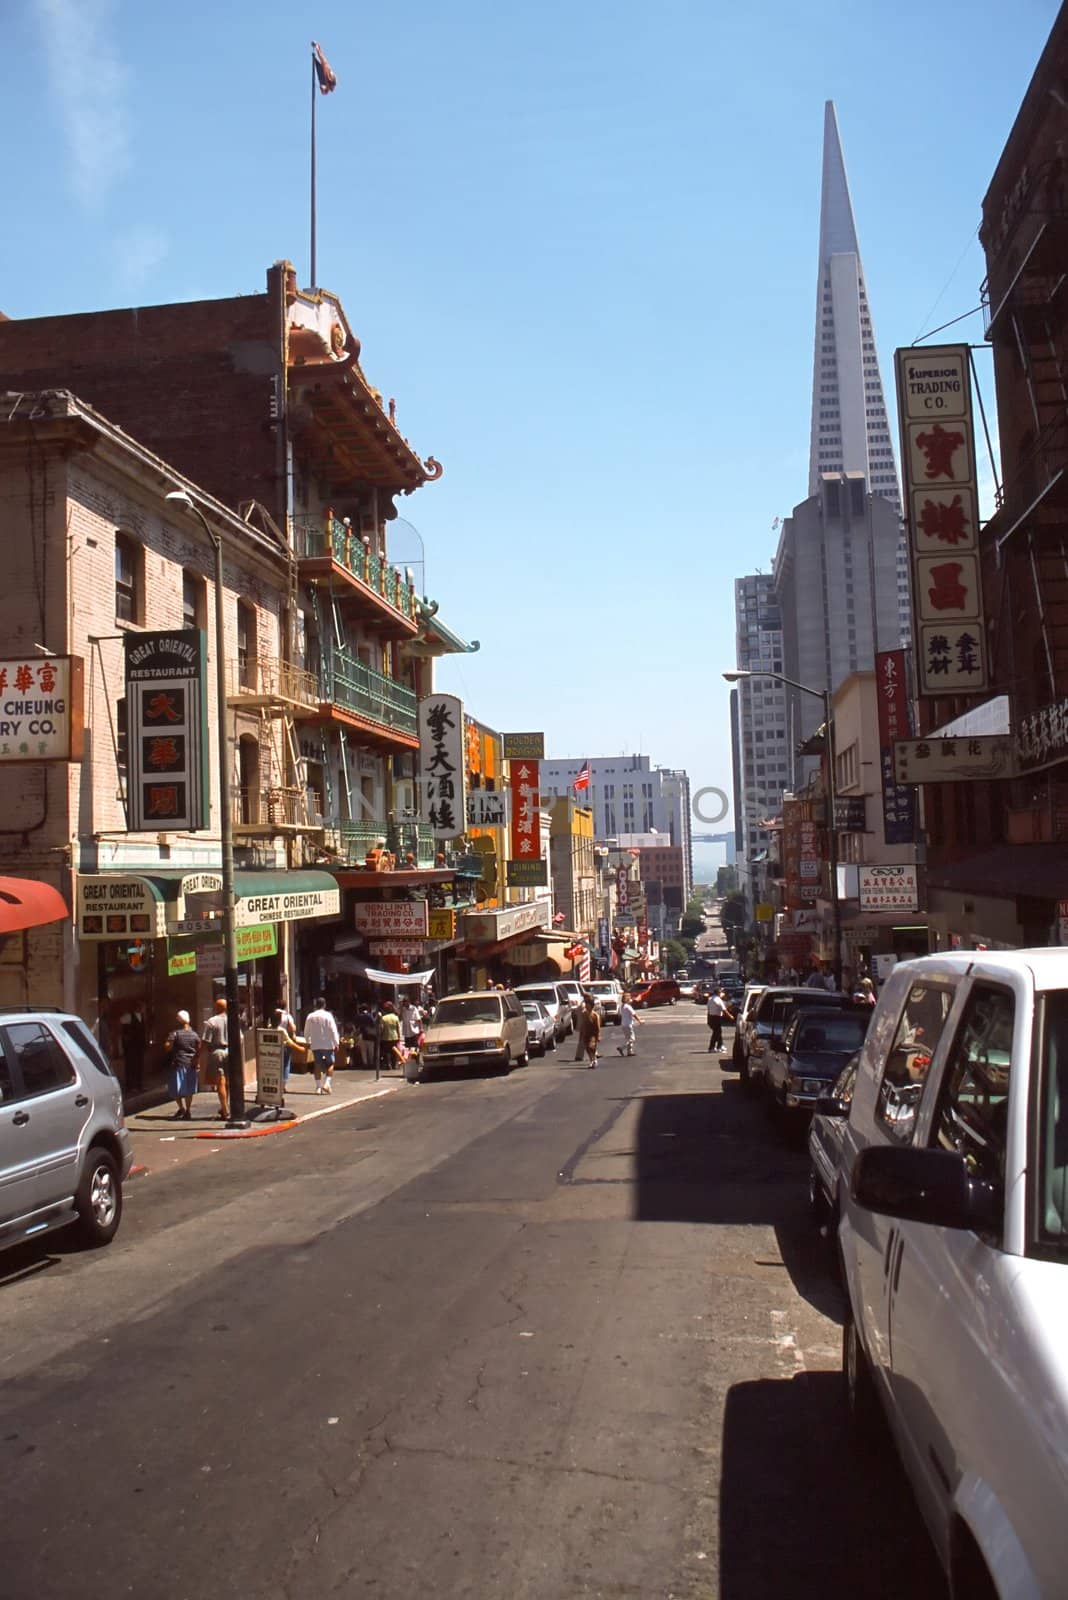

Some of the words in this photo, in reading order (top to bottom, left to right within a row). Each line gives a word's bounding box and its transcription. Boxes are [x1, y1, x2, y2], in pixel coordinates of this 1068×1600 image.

[908, 367, 958, 380] SUPERIOR
[909, 380, 961, 395] TRADING
[129, 640, 156, 665] GREAT
[159, 638, 197, 662] ORIENTAL
[130, 666, 196, 679] RESTAURANT
[4, 699, 65, 715] CHEUNG
[28, 720, 57, 735] CO.
[507, 735, 541, 745] GOLDEN
[505, 746, 542, 756] DRAGON
[83, 884, 107, 899] GREAT
[110, 882, 146, 899] ORIENTAL
[86, 902, 145, 912] RESTAURANT
[247, 897, 281, 912] GREAT
[283, 893, 323, 909] ORIENTAL
[259, 910, 283, 922] CHINESE
[283, 907, 314, 918] RESTAURANT
[367, 910, 402, 918] TRADING
[176, 922, 212, 933] ROSS
